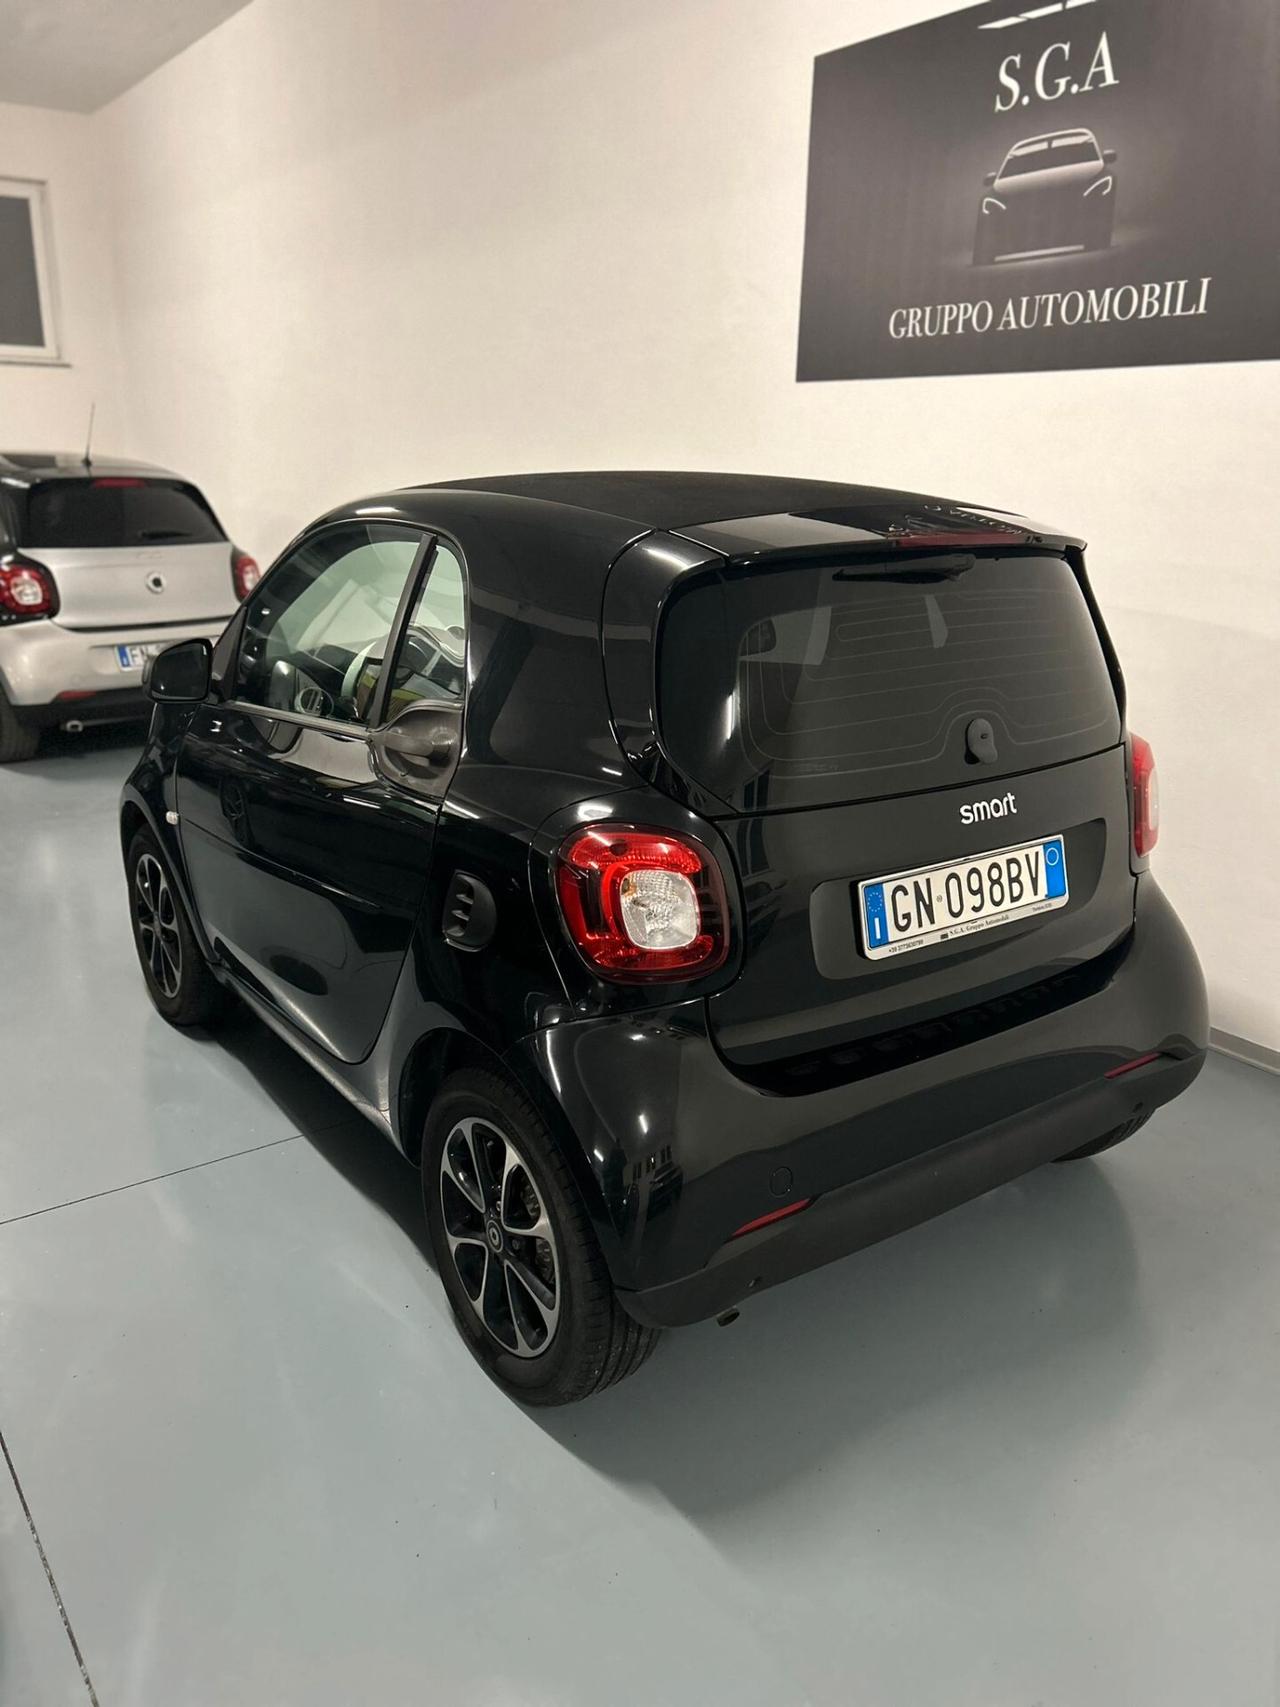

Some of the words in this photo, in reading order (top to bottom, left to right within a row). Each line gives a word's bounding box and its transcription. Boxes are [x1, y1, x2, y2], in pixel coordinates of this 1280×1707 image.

[994, 31, 1119, 112] S.G.A
[889, 301, 993, 339] GRUPPO
[998, 278, 1212, 331] AUTOMOBILI
[959, 792, 1018, 824] smart
[891, 878, 936, 932] GN
[945, 851, 1040, 918] 098BV
